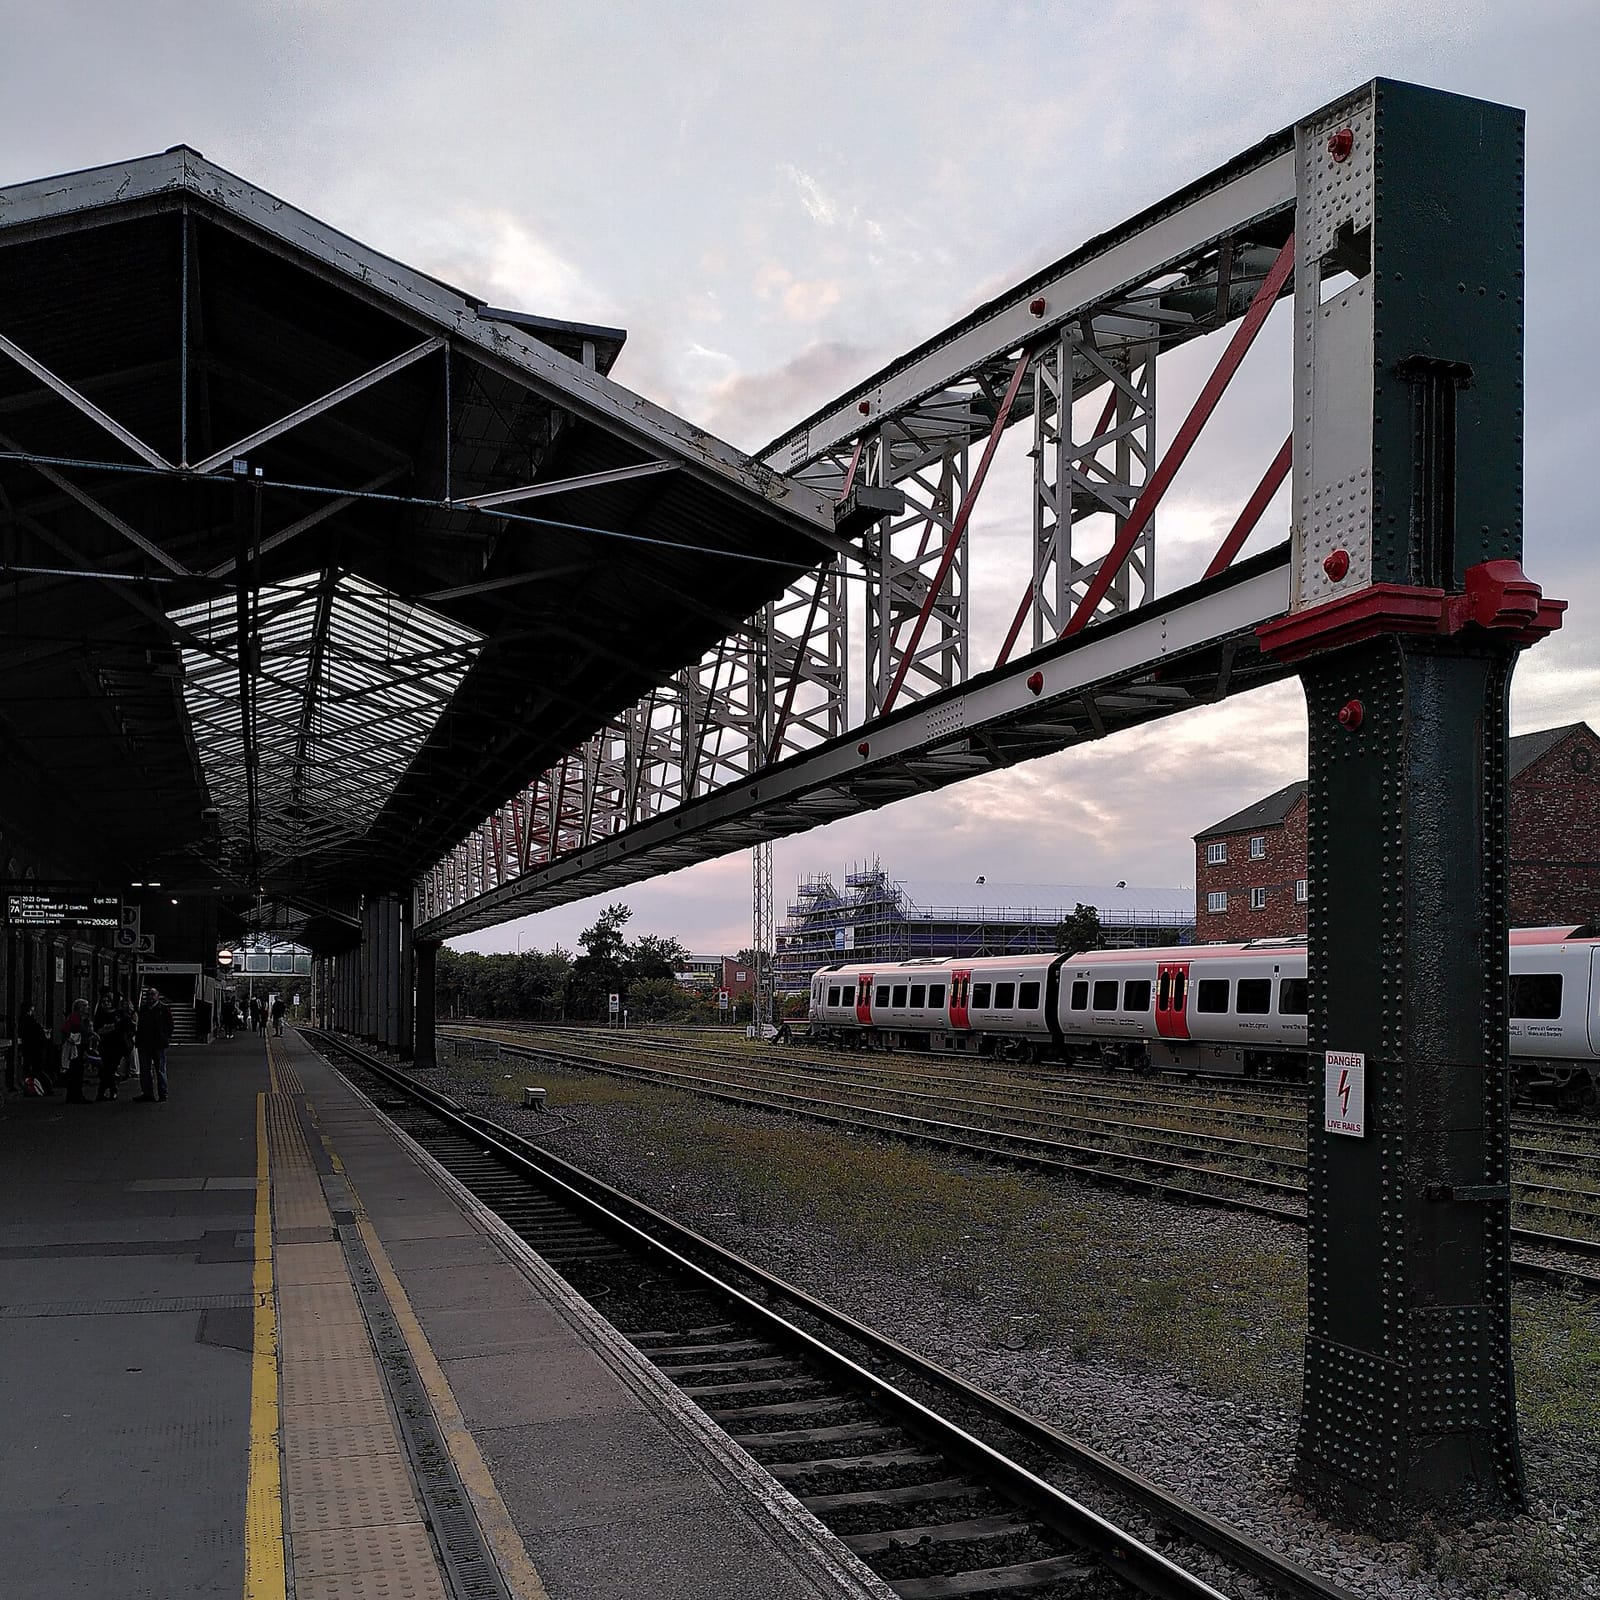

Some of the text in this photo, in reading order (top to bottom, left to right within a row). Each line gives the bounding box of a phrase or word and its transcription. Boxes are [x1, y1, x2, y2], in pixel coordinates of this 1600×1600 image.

[1327, 1055, 1361, 1067] DANGER
[1327, 1120, 1361, 1132] LIVE RAILS
